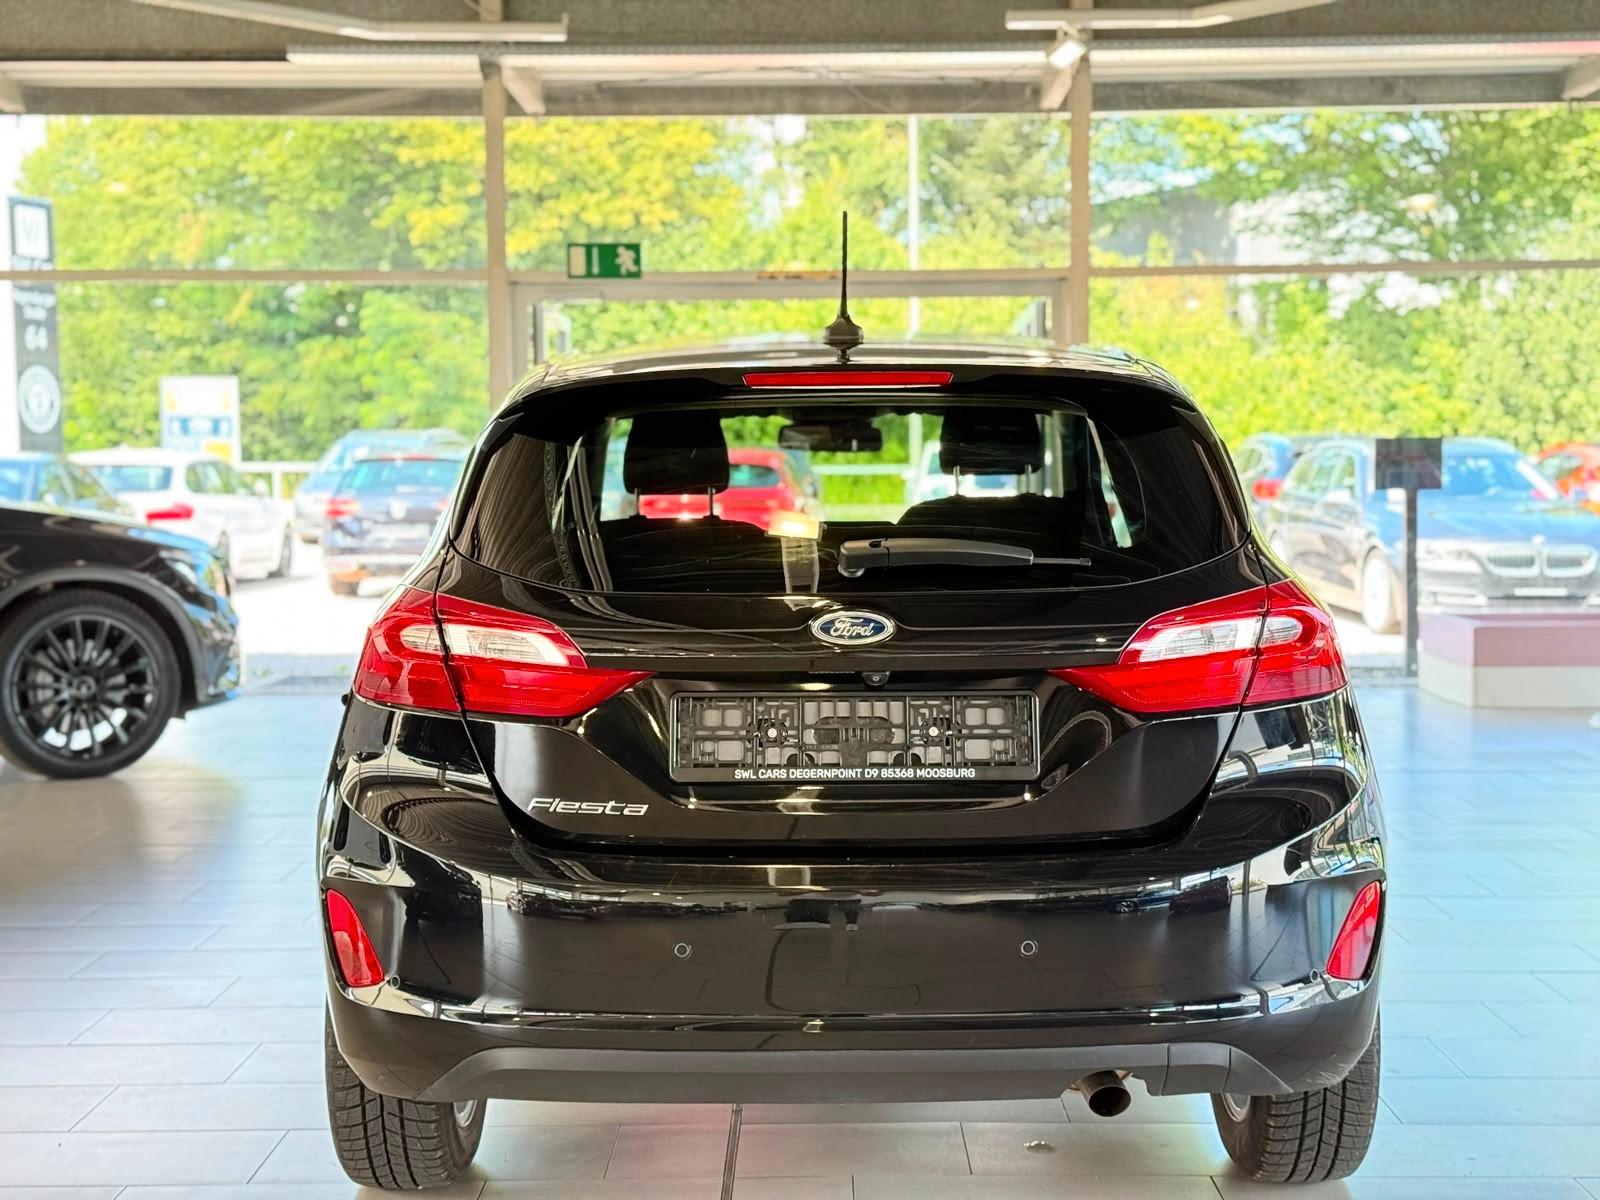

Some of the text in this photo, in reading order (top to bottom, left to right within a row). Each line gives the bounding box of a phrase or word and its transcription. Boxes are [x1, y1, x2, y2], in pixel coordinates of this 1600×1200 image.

[830, 616, 875, 639] Ford
[734, 768, 976, 779] SWL CARS DEGERNPOINT D9 85368 MOOSBURG
[526, 797, 649, 816] Fiesta
